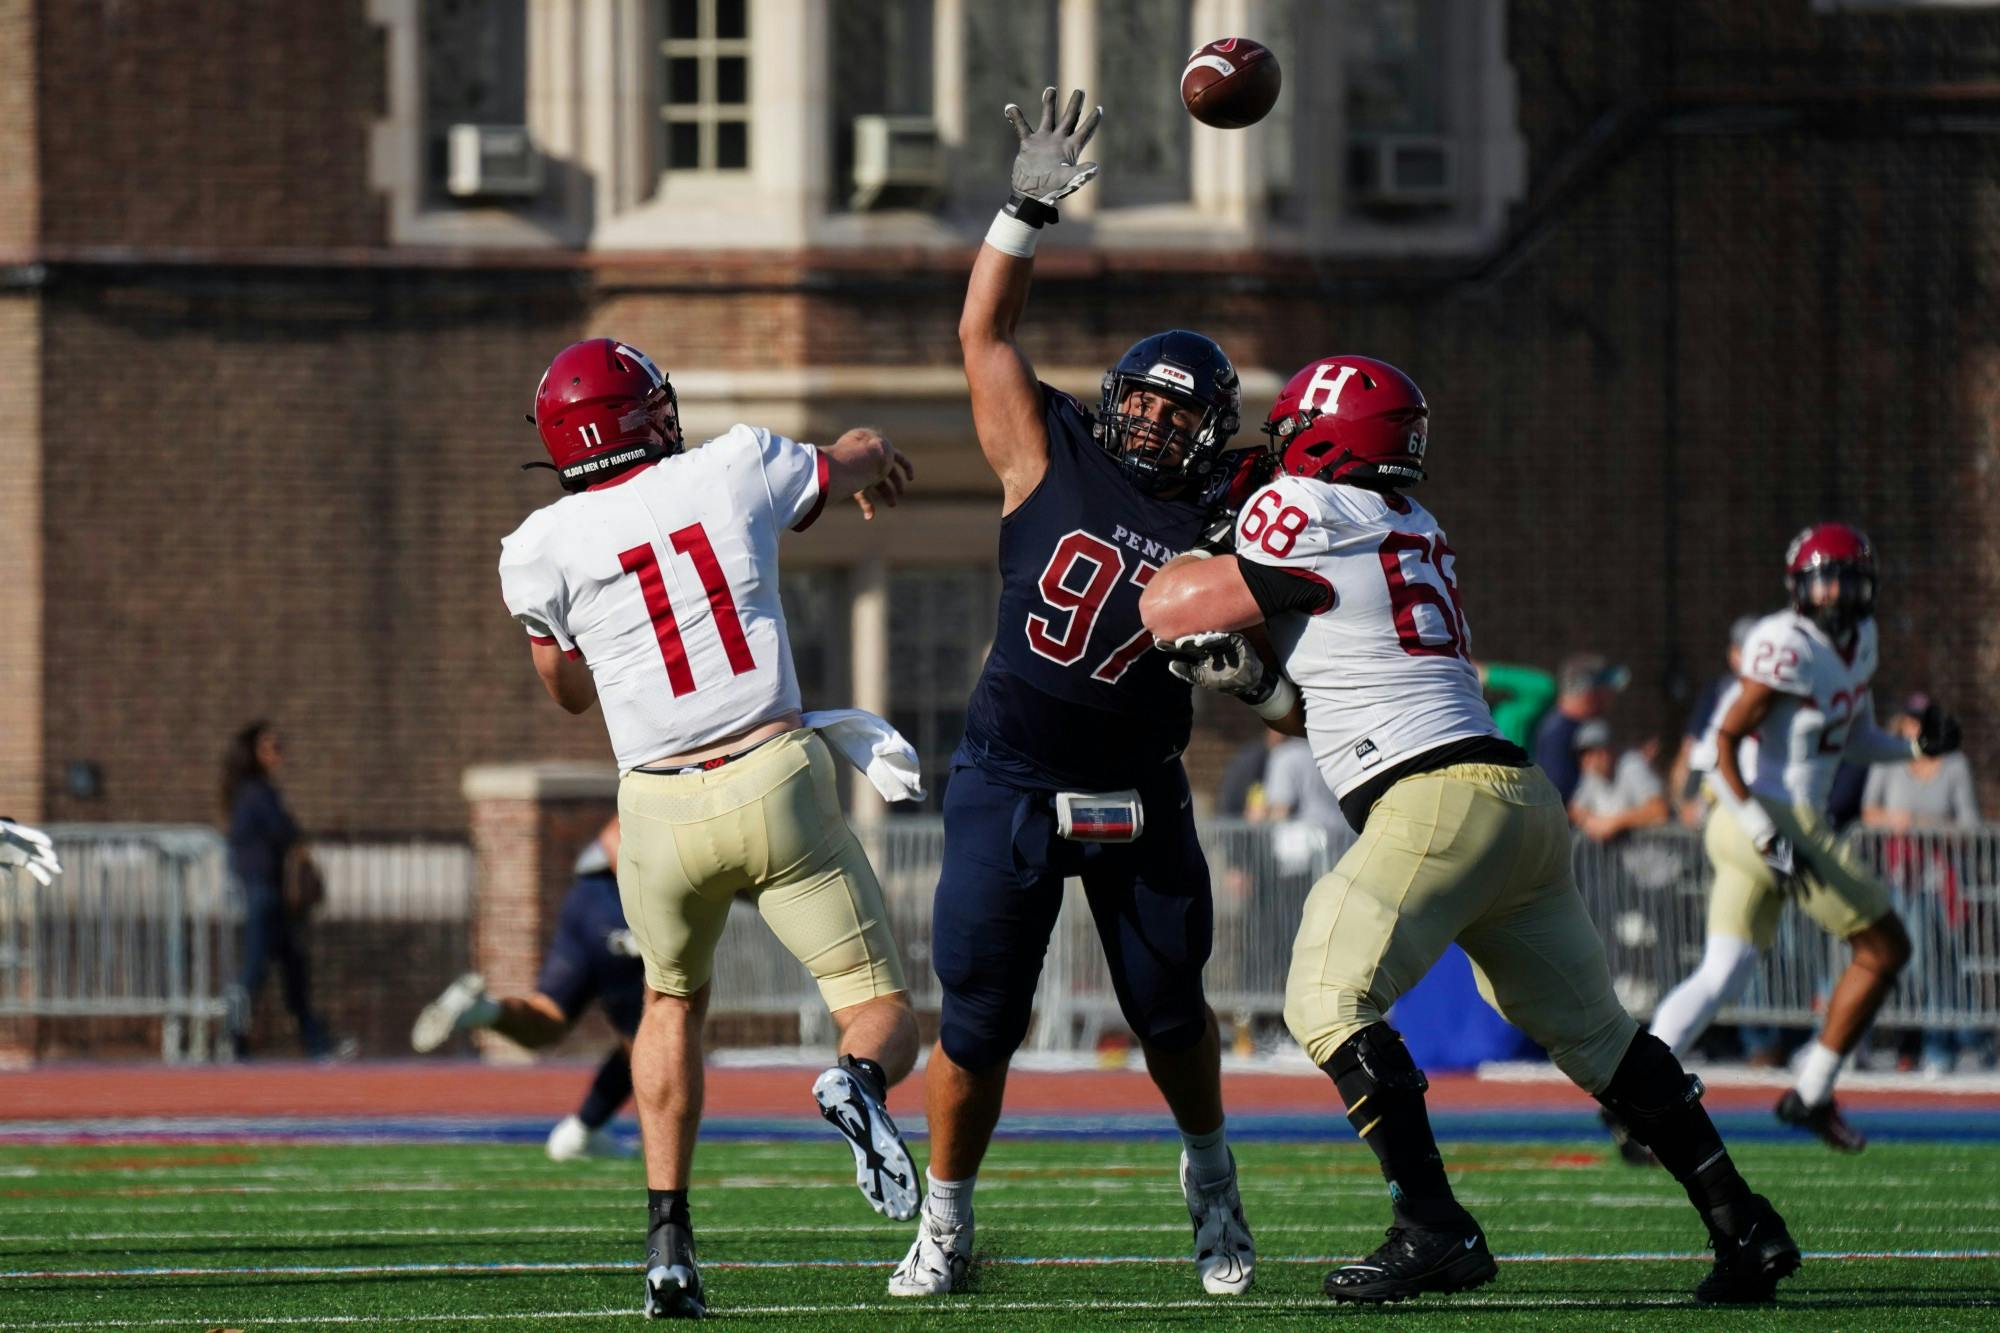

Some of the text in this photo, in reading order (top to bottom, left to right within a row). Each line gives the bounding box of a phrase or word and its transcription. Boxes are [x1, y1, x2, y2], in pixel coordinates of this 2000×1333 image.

[1162, 368, 1186, 380] PENN
[1298, 364, 1358, 415] H
[578, 422, 602, 448] 11
[1408, 432, 1427, 458] 68
[563, 448, 646, 478] 10,000 MEN OF HARVARD
[1240, 489, 1308, 558] 68
[618, 521, 757, 698] 11
[1753, 640, 1799, 683] 22
